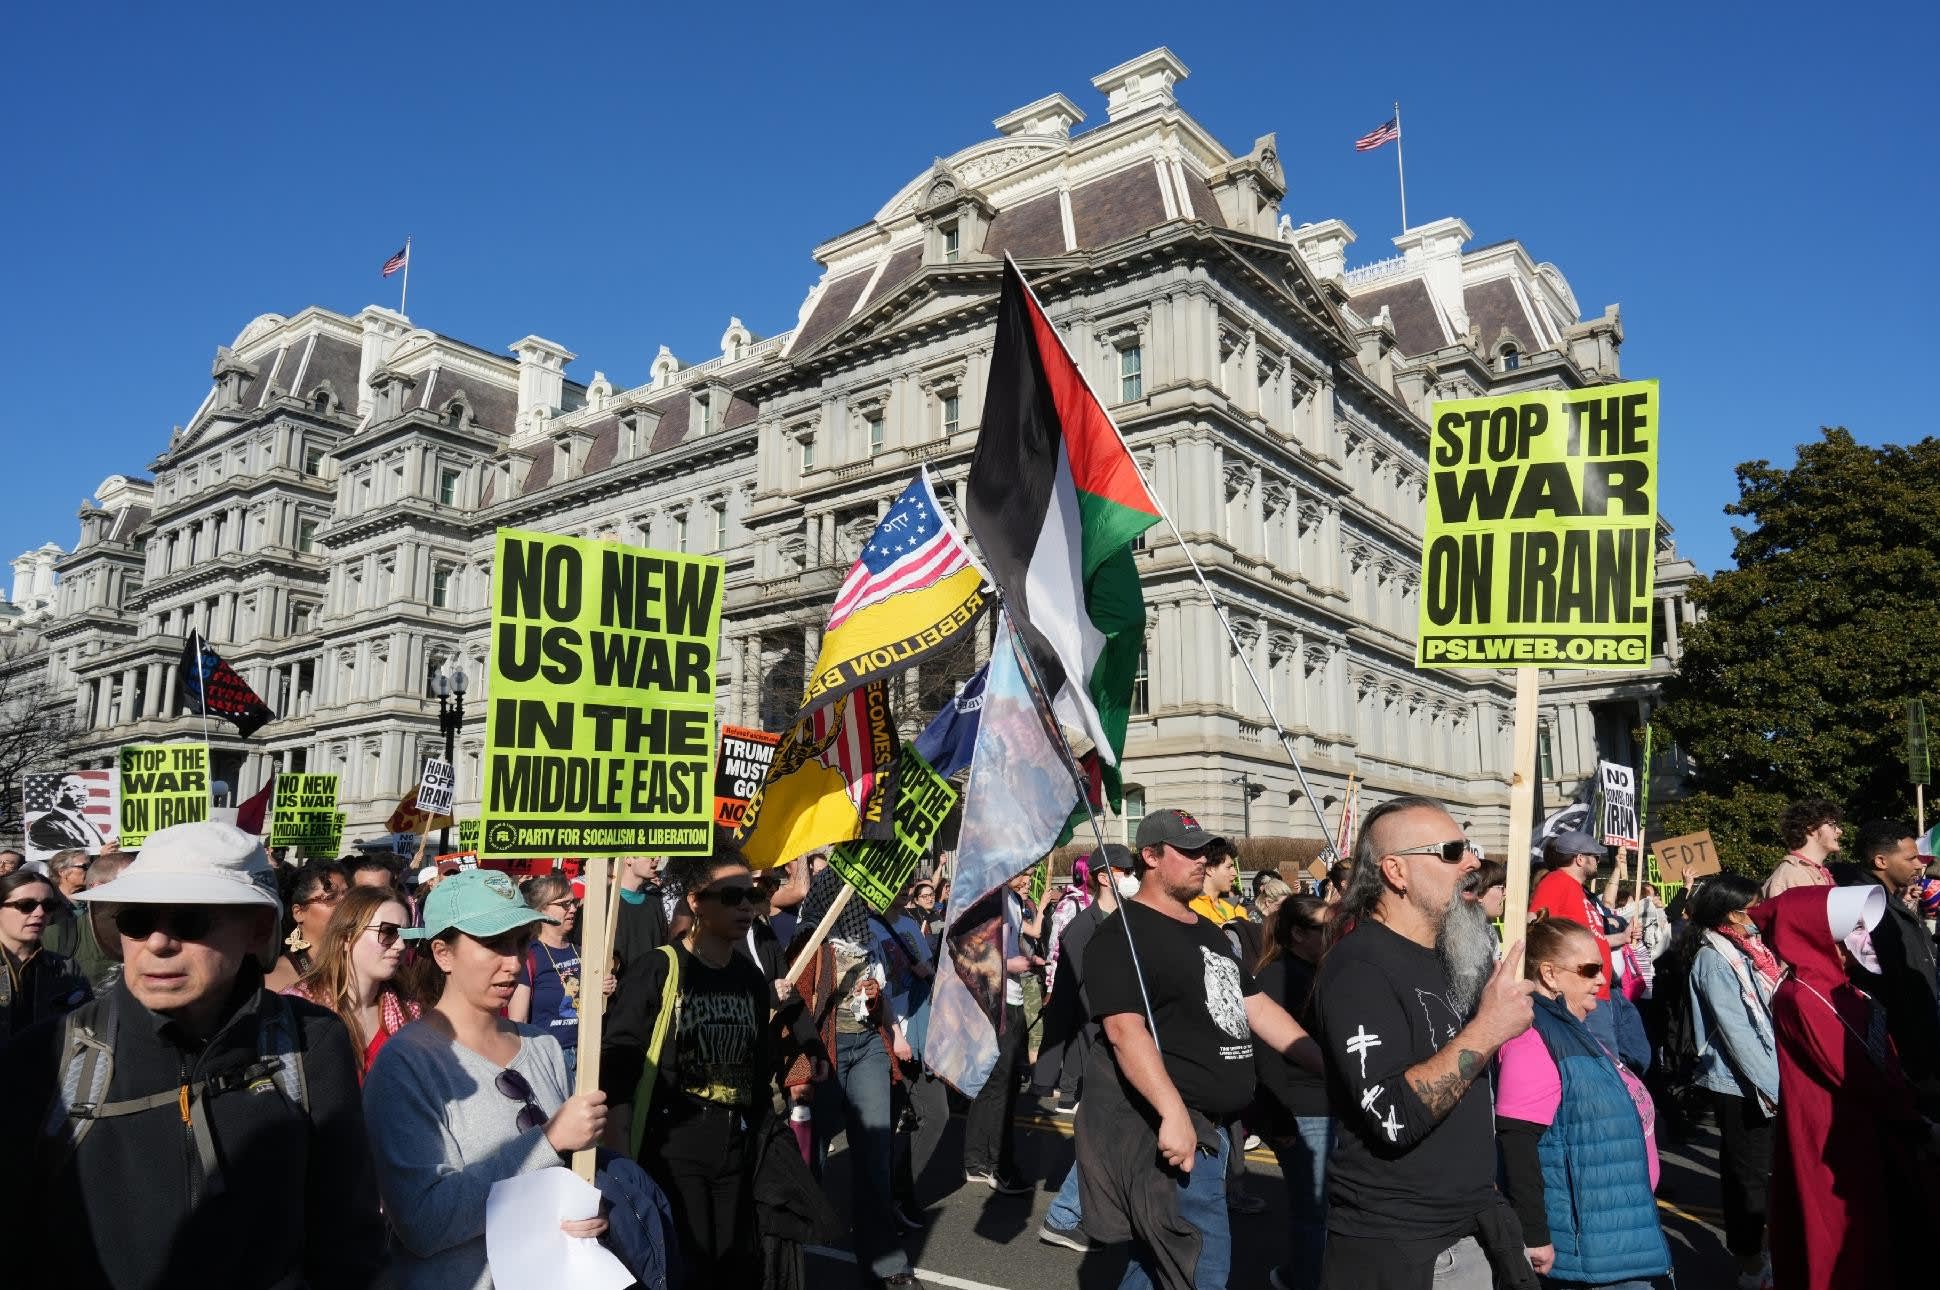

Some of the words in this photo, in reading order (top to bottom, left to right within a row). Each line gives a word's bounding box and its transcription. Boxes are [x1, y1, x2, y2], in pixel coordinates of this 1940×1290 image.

[1436, 402, 1549, 467] STOP
[1562, 392, 1648, 457] THE
[1434, 460, 1650, 524] WAR
[501, 538, 582, 622] NO
[600, 550, 720, 637] NEW
[1427, 533, 1494, 626] ON
[1507, 528, 1650, 624] IRAN!
[498, 623, 583, 684] US
[590, 631, 711, 694] WAR
[1426, 638, 1645, 661] PSLWEB.ORG
[494, 698, 574, 750] IN
[583, 703, 708, 756] THE
[867, 680, 891, 766] ECOMES
[122, 750, 166, 772] STOP
[172, 749, 205, 770] THE
[427, 760, 455, 779] HAND
[725, 758, 770, 781] MUST
[122, 772, 206, 794] WAR
[278, 776, 299, 794] NO
[303, 776, 337, 794] NEW
[424, 775, 455, 788] OFF
[490, 754, 625, 813] MIDDLE
[630, 759, 708, 814] EAST
[1606, 767, 1629, 788] NO
[277, 795, 297, 807] US
[300, 796, 335, 807] WAR
[419, 786, 453, 808] IRAN!
[921, 782, 951, 822] THE
[122, 798, 149, 833] ON
[155, 796, 207, 831] IRAN!
[275, 812, 294, 822] IN
[297, 812, 333, 822] THE
[718, 803, 747, 821] NO
[1607, 804, 1635, 839] IRAN
[273, 824, 309, 836] MIDDLE
[310, 824, 333, 836] EAST
[460, 821, 477, 831] STOP
[460, 831, 479, 840] WA
[518, 828, 555, 846] PARTY
[558, 828, 580, 845] FOR
[583, 828, 635, 845] SOCIALISM
[637, 828, 646, 845] &
[649, 828, 707, 846] LIBERATION
[1661, 840, 1708, 870] FDT
